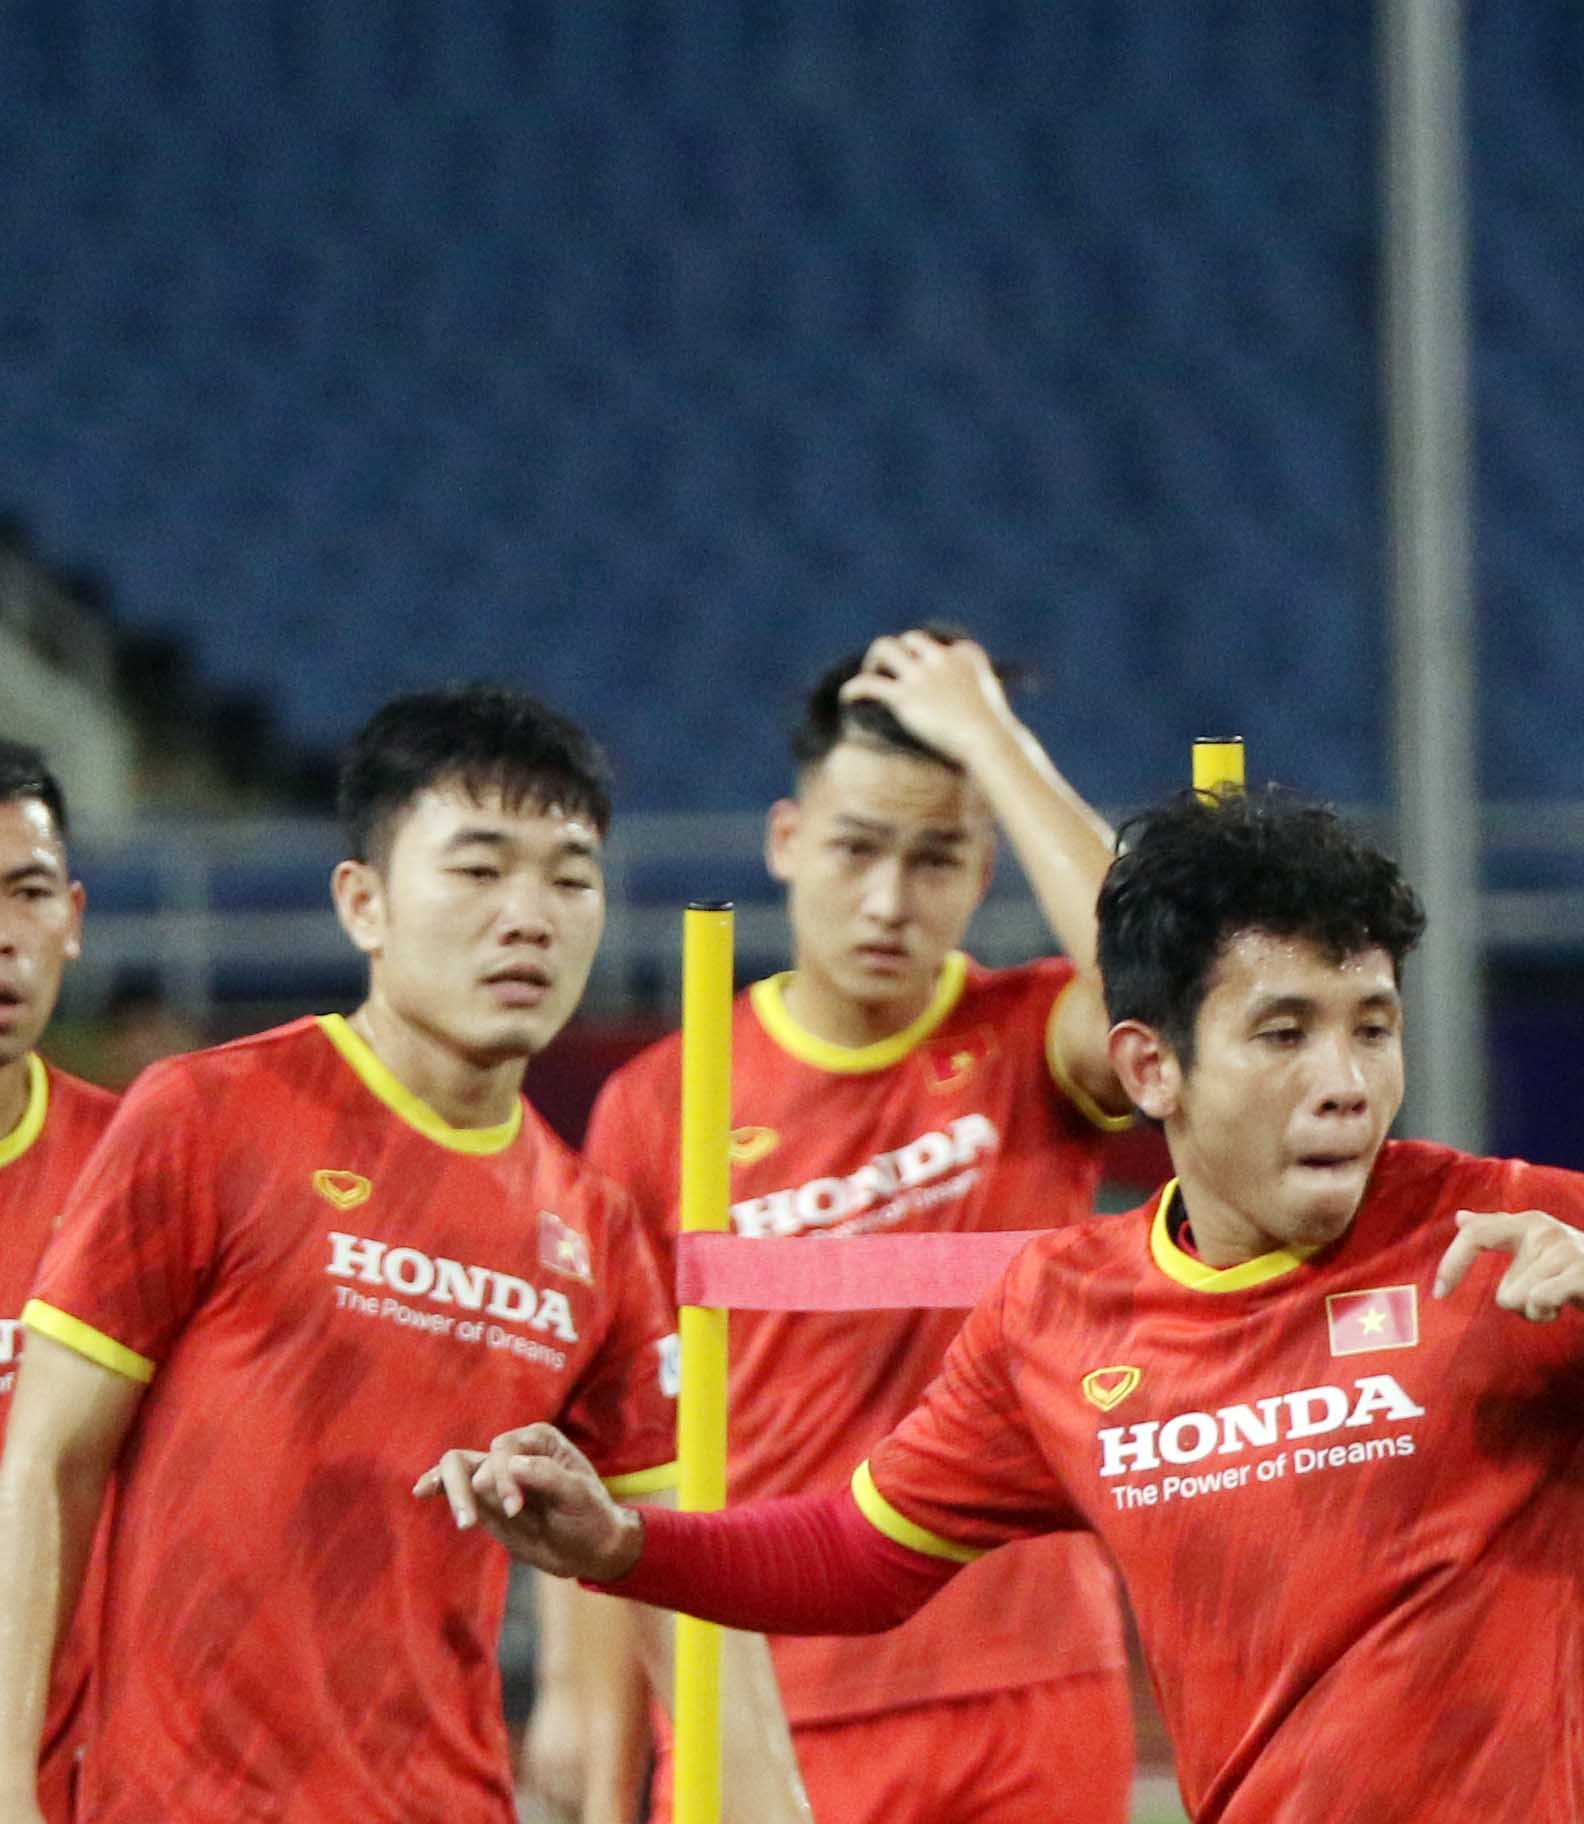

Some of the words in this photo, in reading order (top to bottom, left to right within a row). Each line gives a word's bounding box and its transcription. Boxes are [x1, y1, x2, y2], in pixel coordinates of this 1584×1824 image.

[324, 1231, 579, 1343] HONDA
[336, 1286, 379, 1314] The
[380, 1297, 455, 1335] Power
[456, 1320, 485, 1343] of
[487, 1324, 566, 1370] Dreams
[1097, 1374, 1425, 1477] HONDA
[1110, 1484, 1158, 1511] The
[1162, 1464, 1250, 1502] Power
[1256, 1453, 1287, 1481] of
[1294, 1434, 1415, 1475] Dreams
